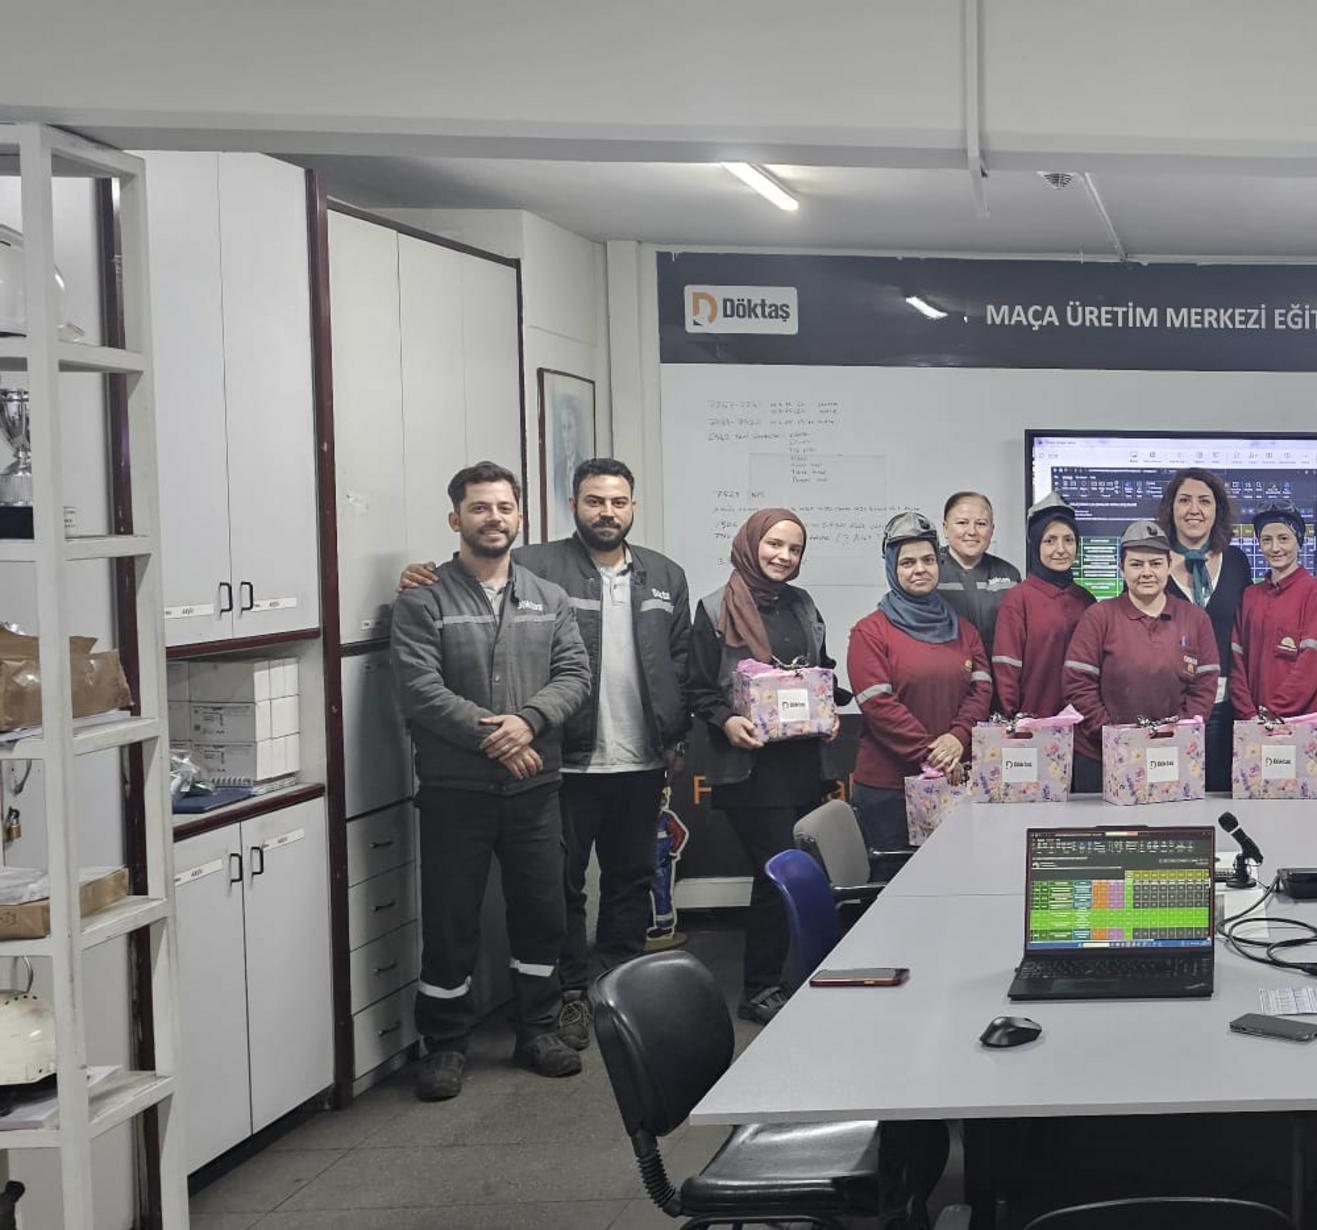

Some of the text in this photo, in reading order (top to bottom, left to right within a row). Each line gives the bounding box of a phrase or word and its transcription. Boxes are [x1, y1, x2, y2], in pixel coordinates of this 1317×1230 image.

[722, 298, 790, 322] Döktaş
[986, 304, 1059, 330] MAÇA
[1066, 301, 1158, 328] ÜRETİM
[1165, 304, 1266, 330] MERKEZİ
